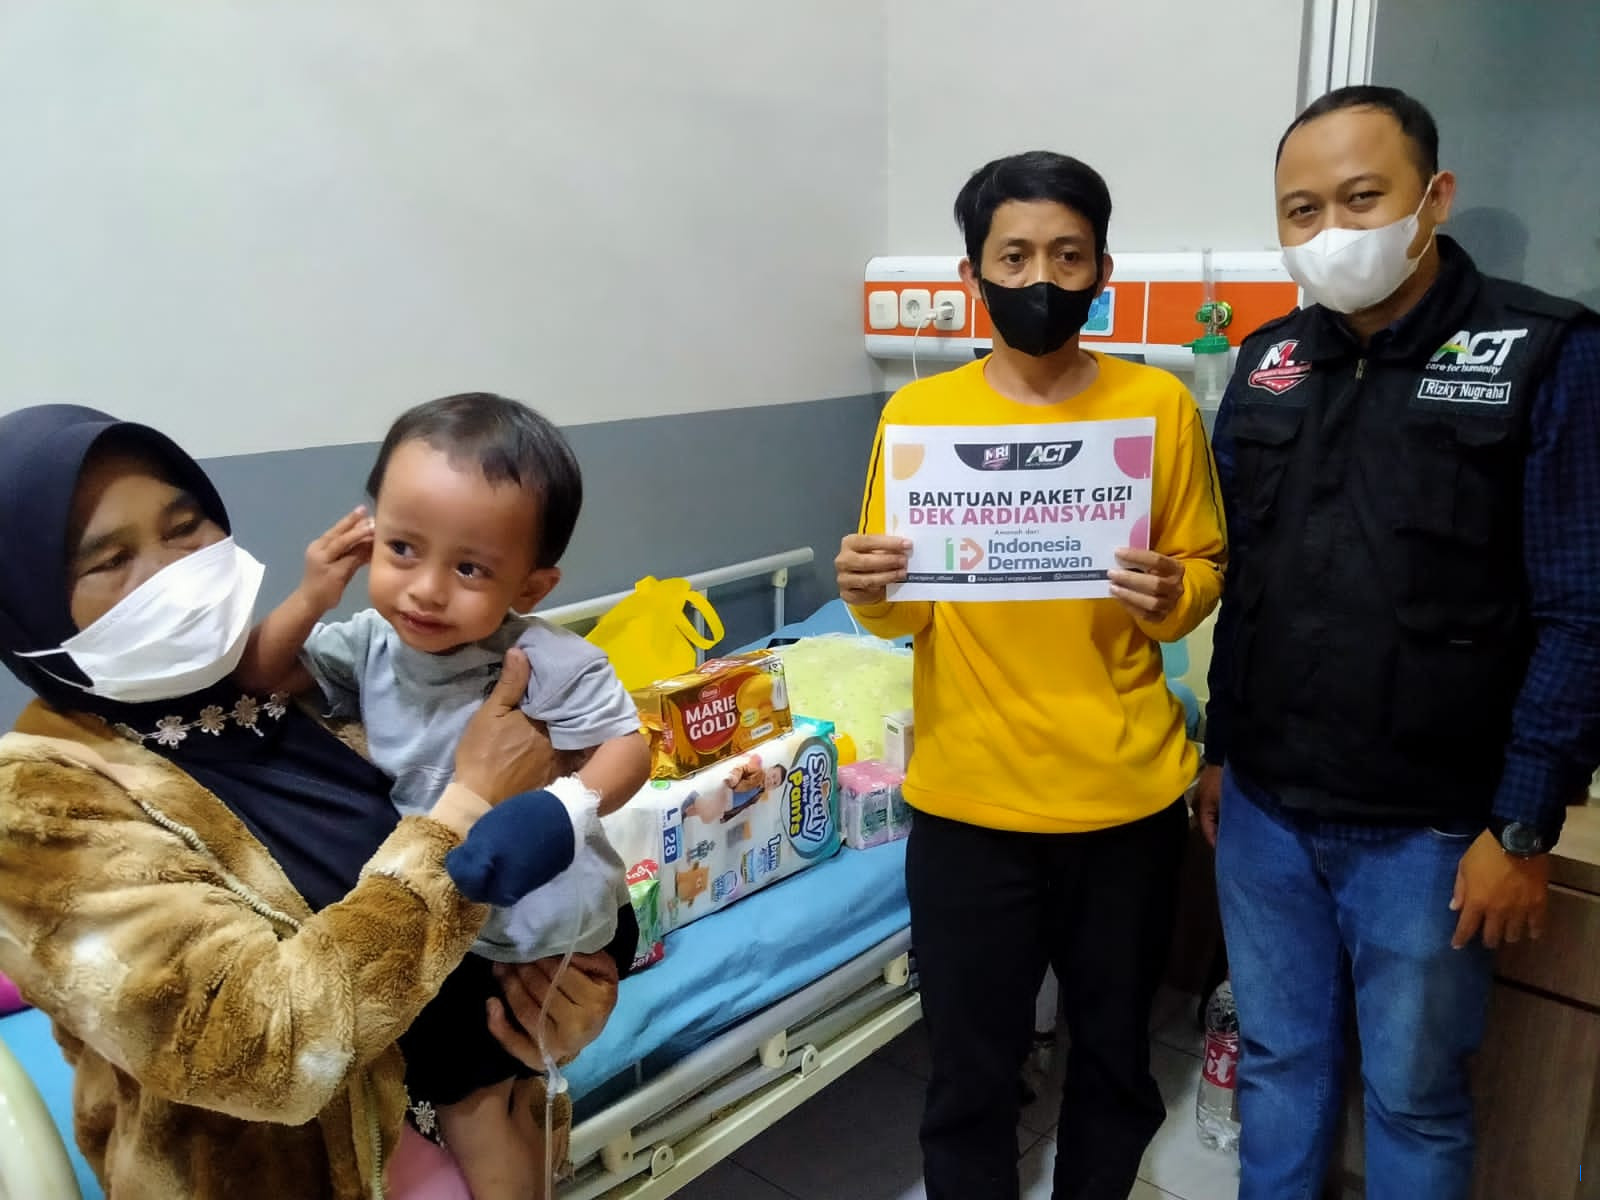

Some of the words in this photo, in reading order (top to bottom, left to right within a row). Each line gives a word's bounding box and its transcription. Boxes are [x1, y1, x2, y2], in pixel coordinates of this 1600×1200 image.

[1434, 328, 1528, 366] ACT
[1425, 363, 1445, 372] care
[1446, 364, 1459, 374] for
[1460, 363, 1502, 376] humanity
[1426, 382, 1457, 398] Rizky
[1460, 384, 1504, 400] Nugraha
[1025, 443, 1072, 463] ACT
[909, 491, 1012, 507] BANTUAN
[1020, 488, 1085, 505] PAKET
[1091, 485, 1132, 502] GIZI
[909, 507, 954, 525] DEK
[961, 503, 1125, 525] ARDIANSYAH
[988, 536, 1082, 554] Indonesia
[988, 554, 1093, 571] Dermawan
[685, 694, 736, 725] MARIE
[689, 712, 736, 741] GOLD
[804, 753, 829, 841] Sweety
[665, 833, 676, 857] 28
